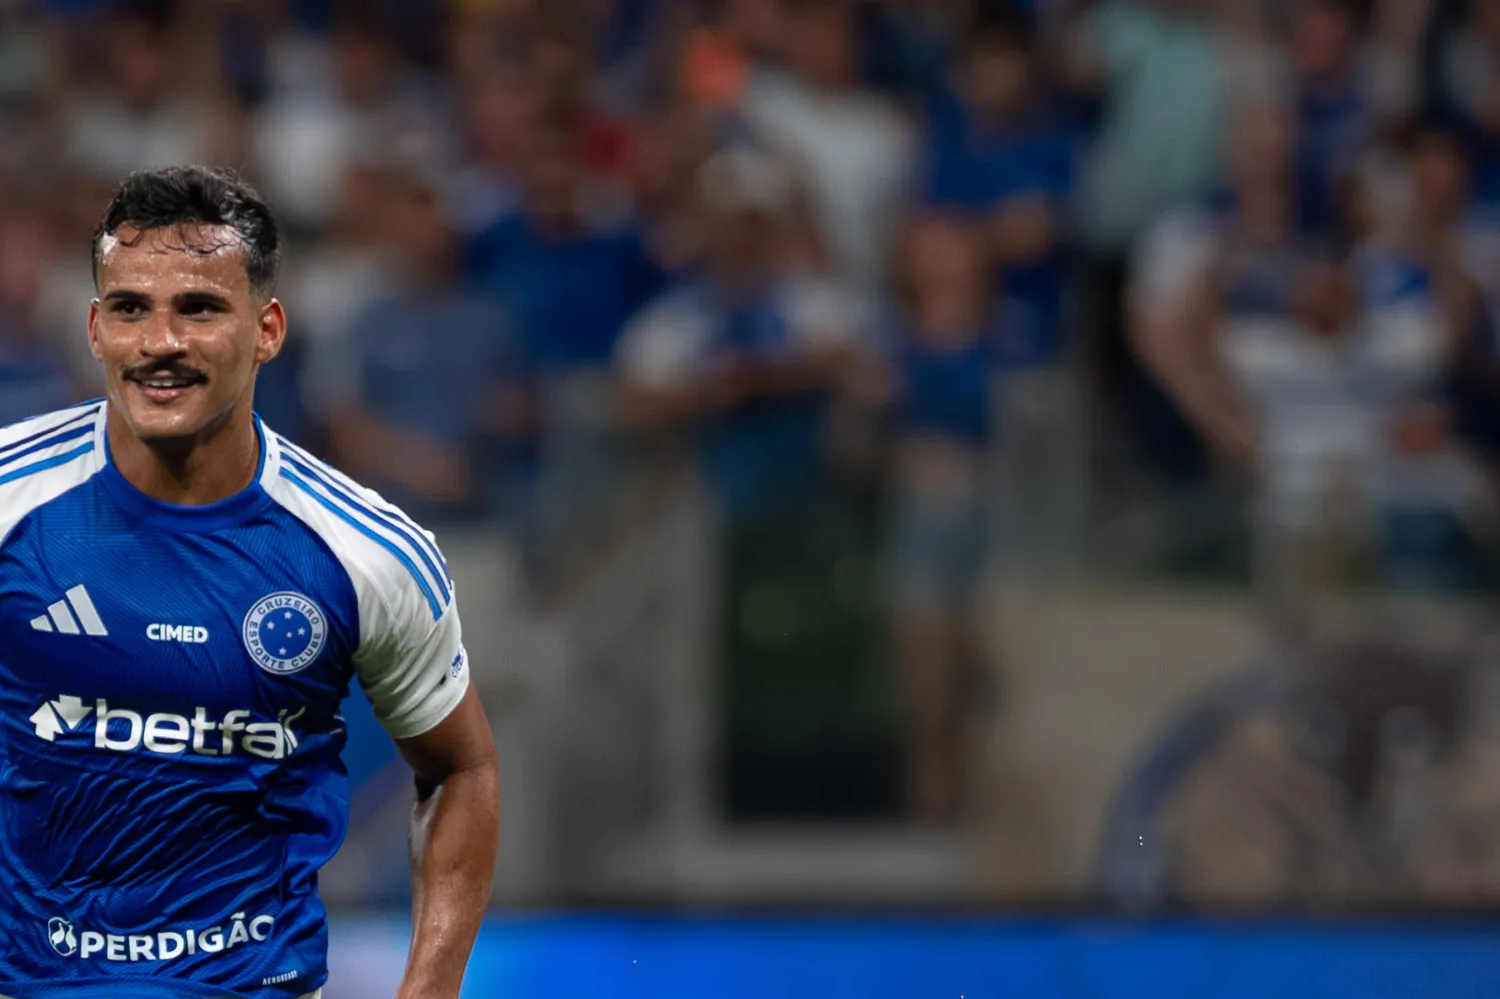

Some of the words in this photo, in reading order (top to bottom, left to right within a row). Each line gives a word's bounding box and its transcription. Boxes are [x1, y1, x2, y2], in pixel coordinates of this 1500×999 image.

[257, 598, 319, 625] CRUZEIRO
[146, 623, 208, 643] CIMED
[249, 621, 285, 669] ESPORTE
[291, 633, 322, 668] CLUBE
[80, 912, 276, 961] PERDIGÃO
